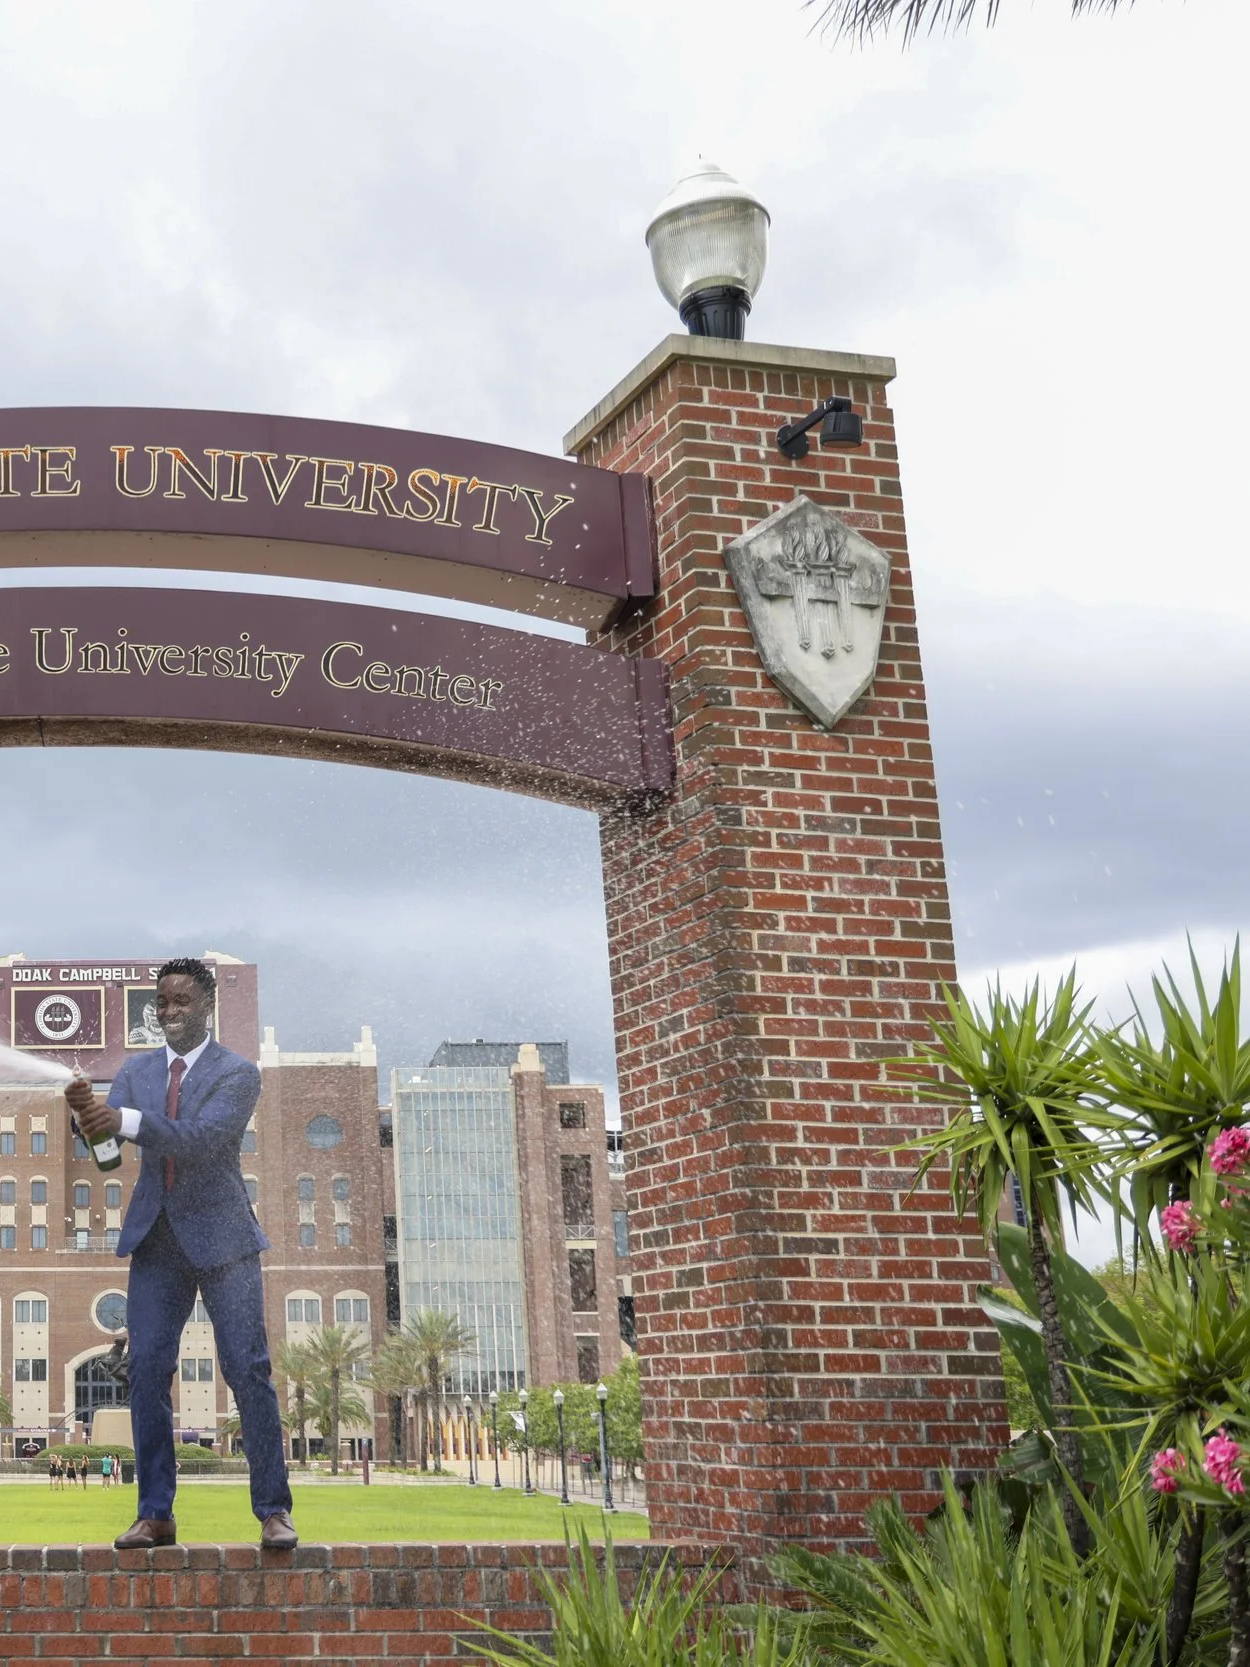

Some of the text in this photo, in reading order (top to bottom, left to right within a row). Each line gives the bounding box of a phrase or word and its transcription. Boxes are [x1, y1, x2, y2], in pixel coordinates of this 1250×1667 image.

[111, 445, 574, 545] UNIVERSITY
[30, 627, 305, 697] University
[320, 641, 504, 711] Center
[12, 968, 53, 982] DOAK
[59, 967, 141, 982] CAMPBELL
